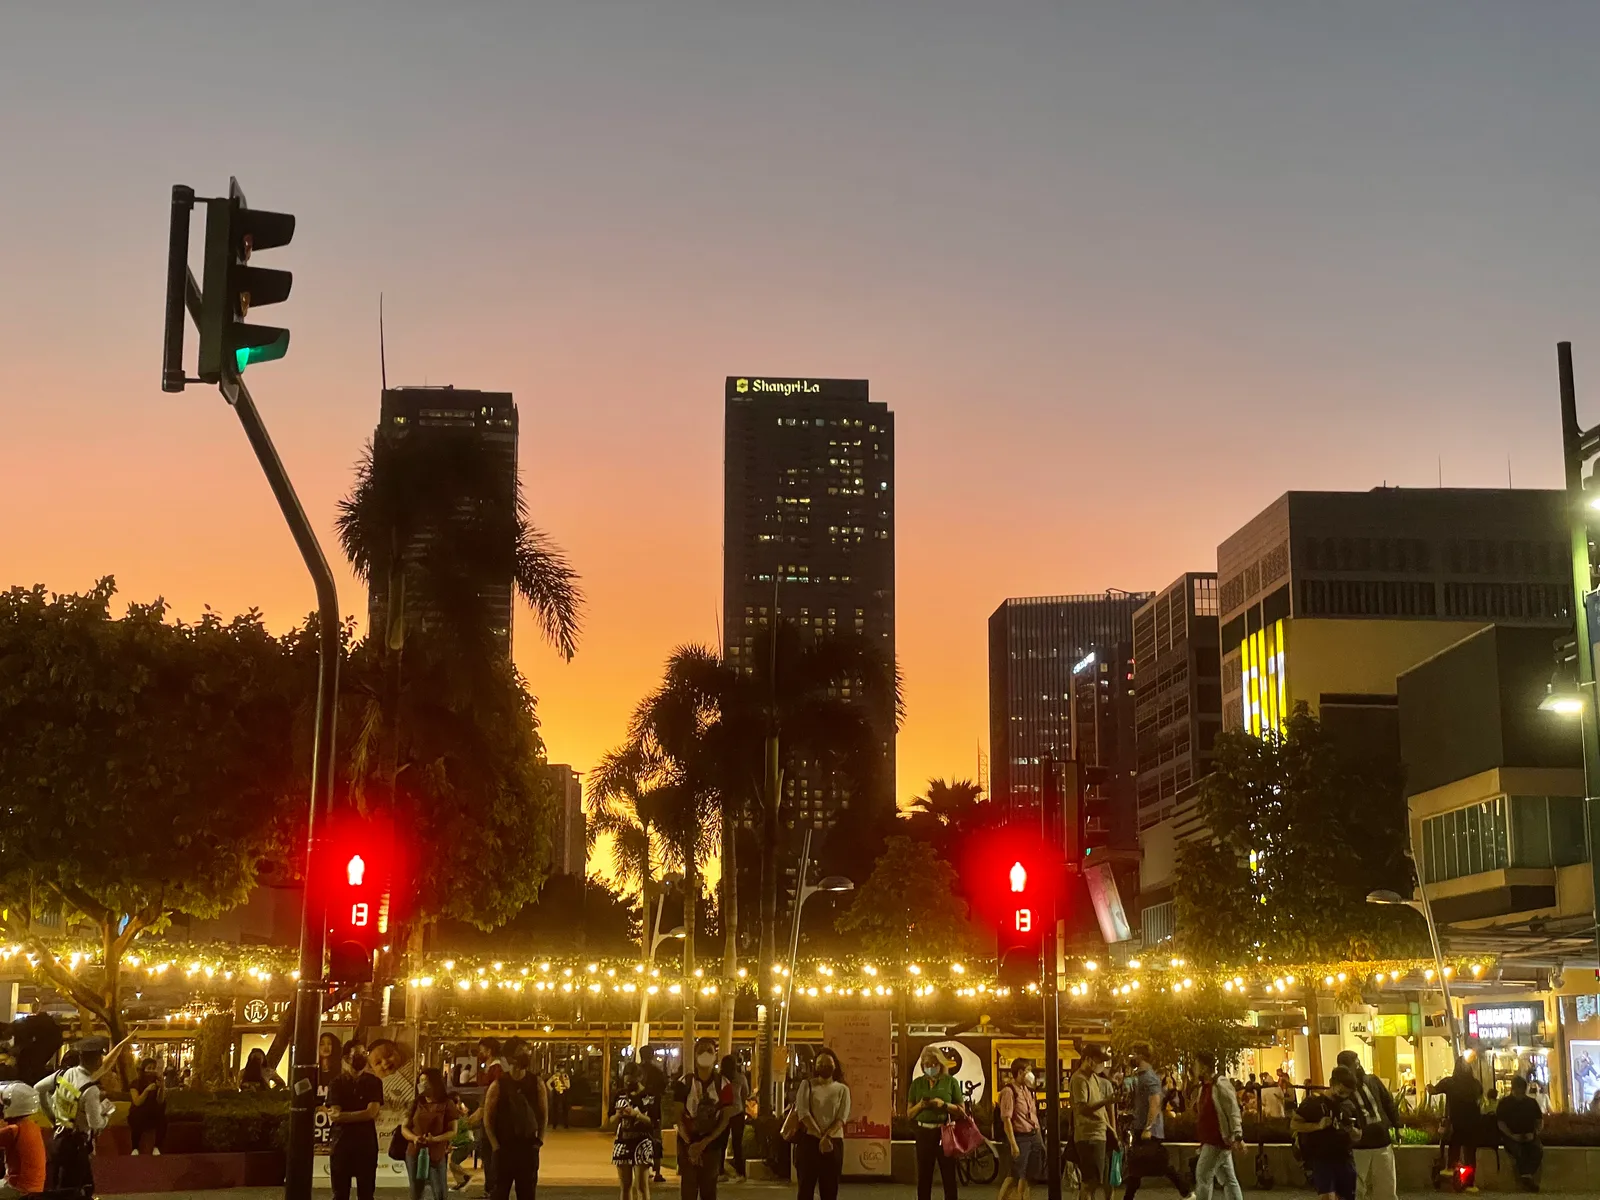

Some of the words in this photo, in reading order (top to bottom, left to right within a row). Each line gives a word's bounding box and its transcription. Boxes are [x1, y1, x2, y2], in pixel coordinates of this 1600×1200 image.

[752, 379, 820, 396] Shangri-La
[351, 902, 368, 926] 13
[1015, 908, 1031, 932] 13
